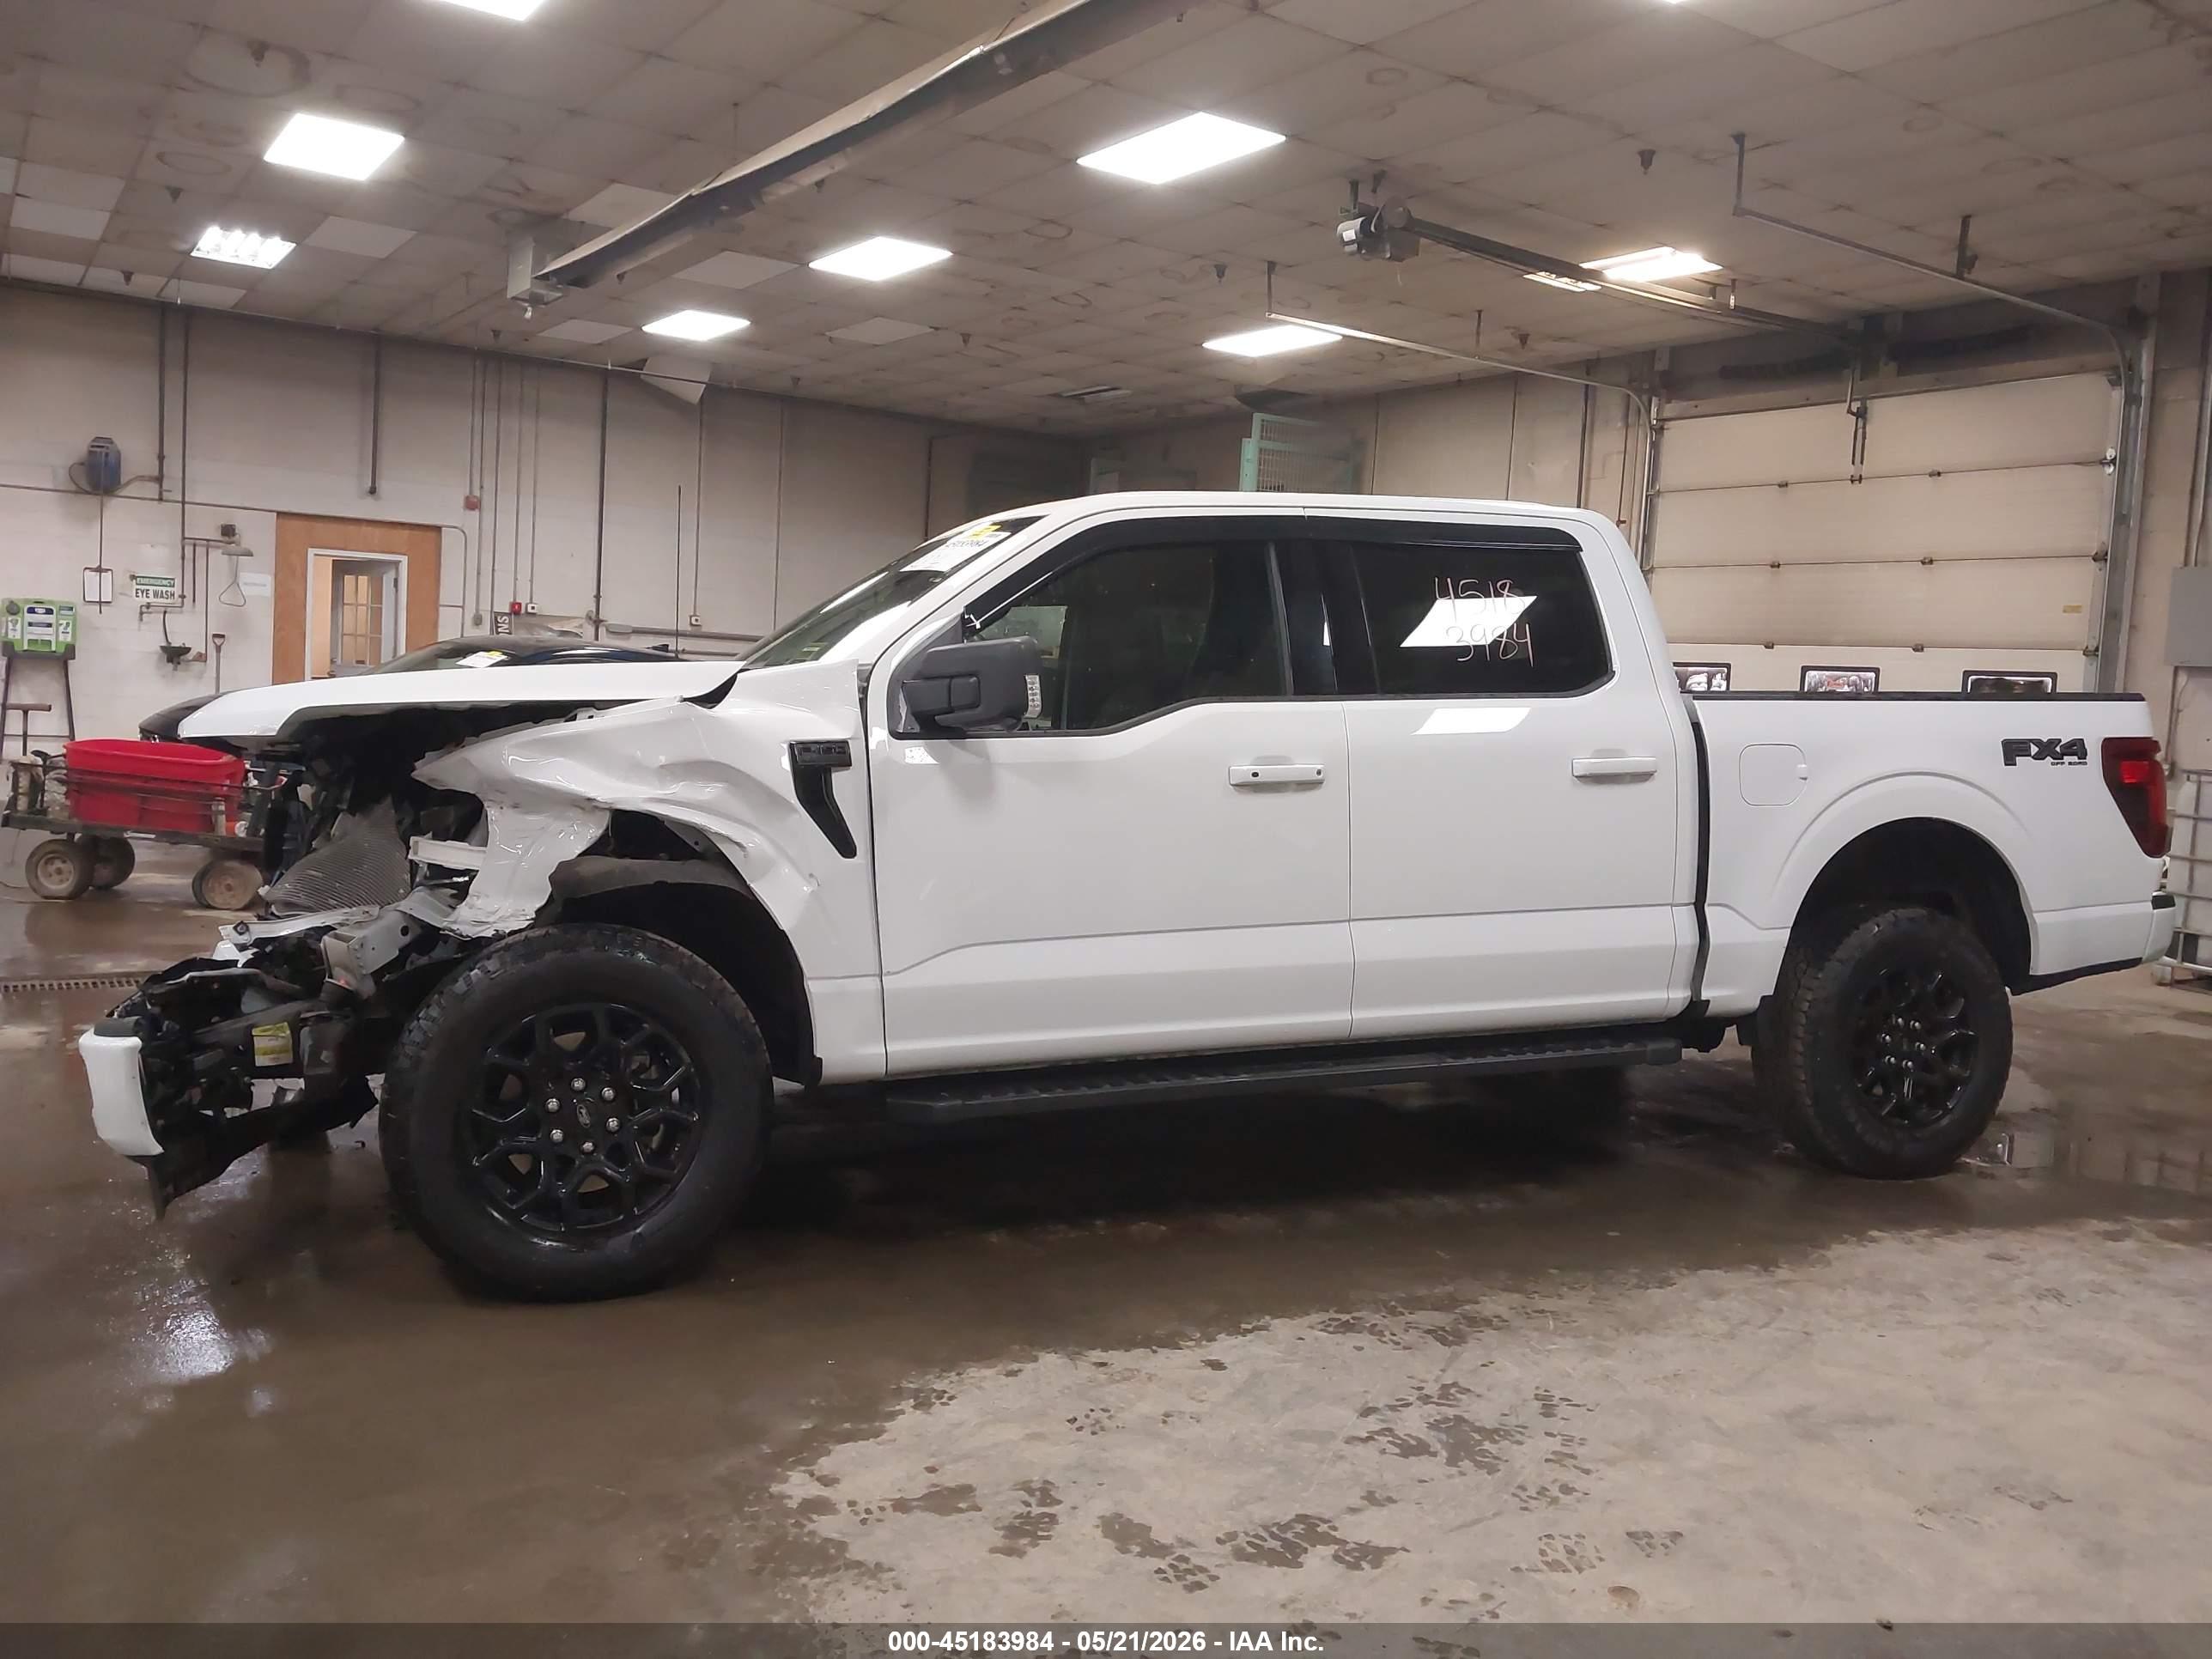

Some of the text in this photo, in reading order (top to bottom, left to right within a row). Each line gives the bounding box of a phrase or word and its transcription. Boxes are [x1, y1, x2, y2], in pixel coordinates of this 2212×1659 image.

[135, 588, 175, 599] EYE WASH
[1435, 577, 1526, 623] 4518
[497, 615, 509, 635] NS
[1446, 623, 1534, 667] 3984
[2001, 738, 2088, 767] FX4
